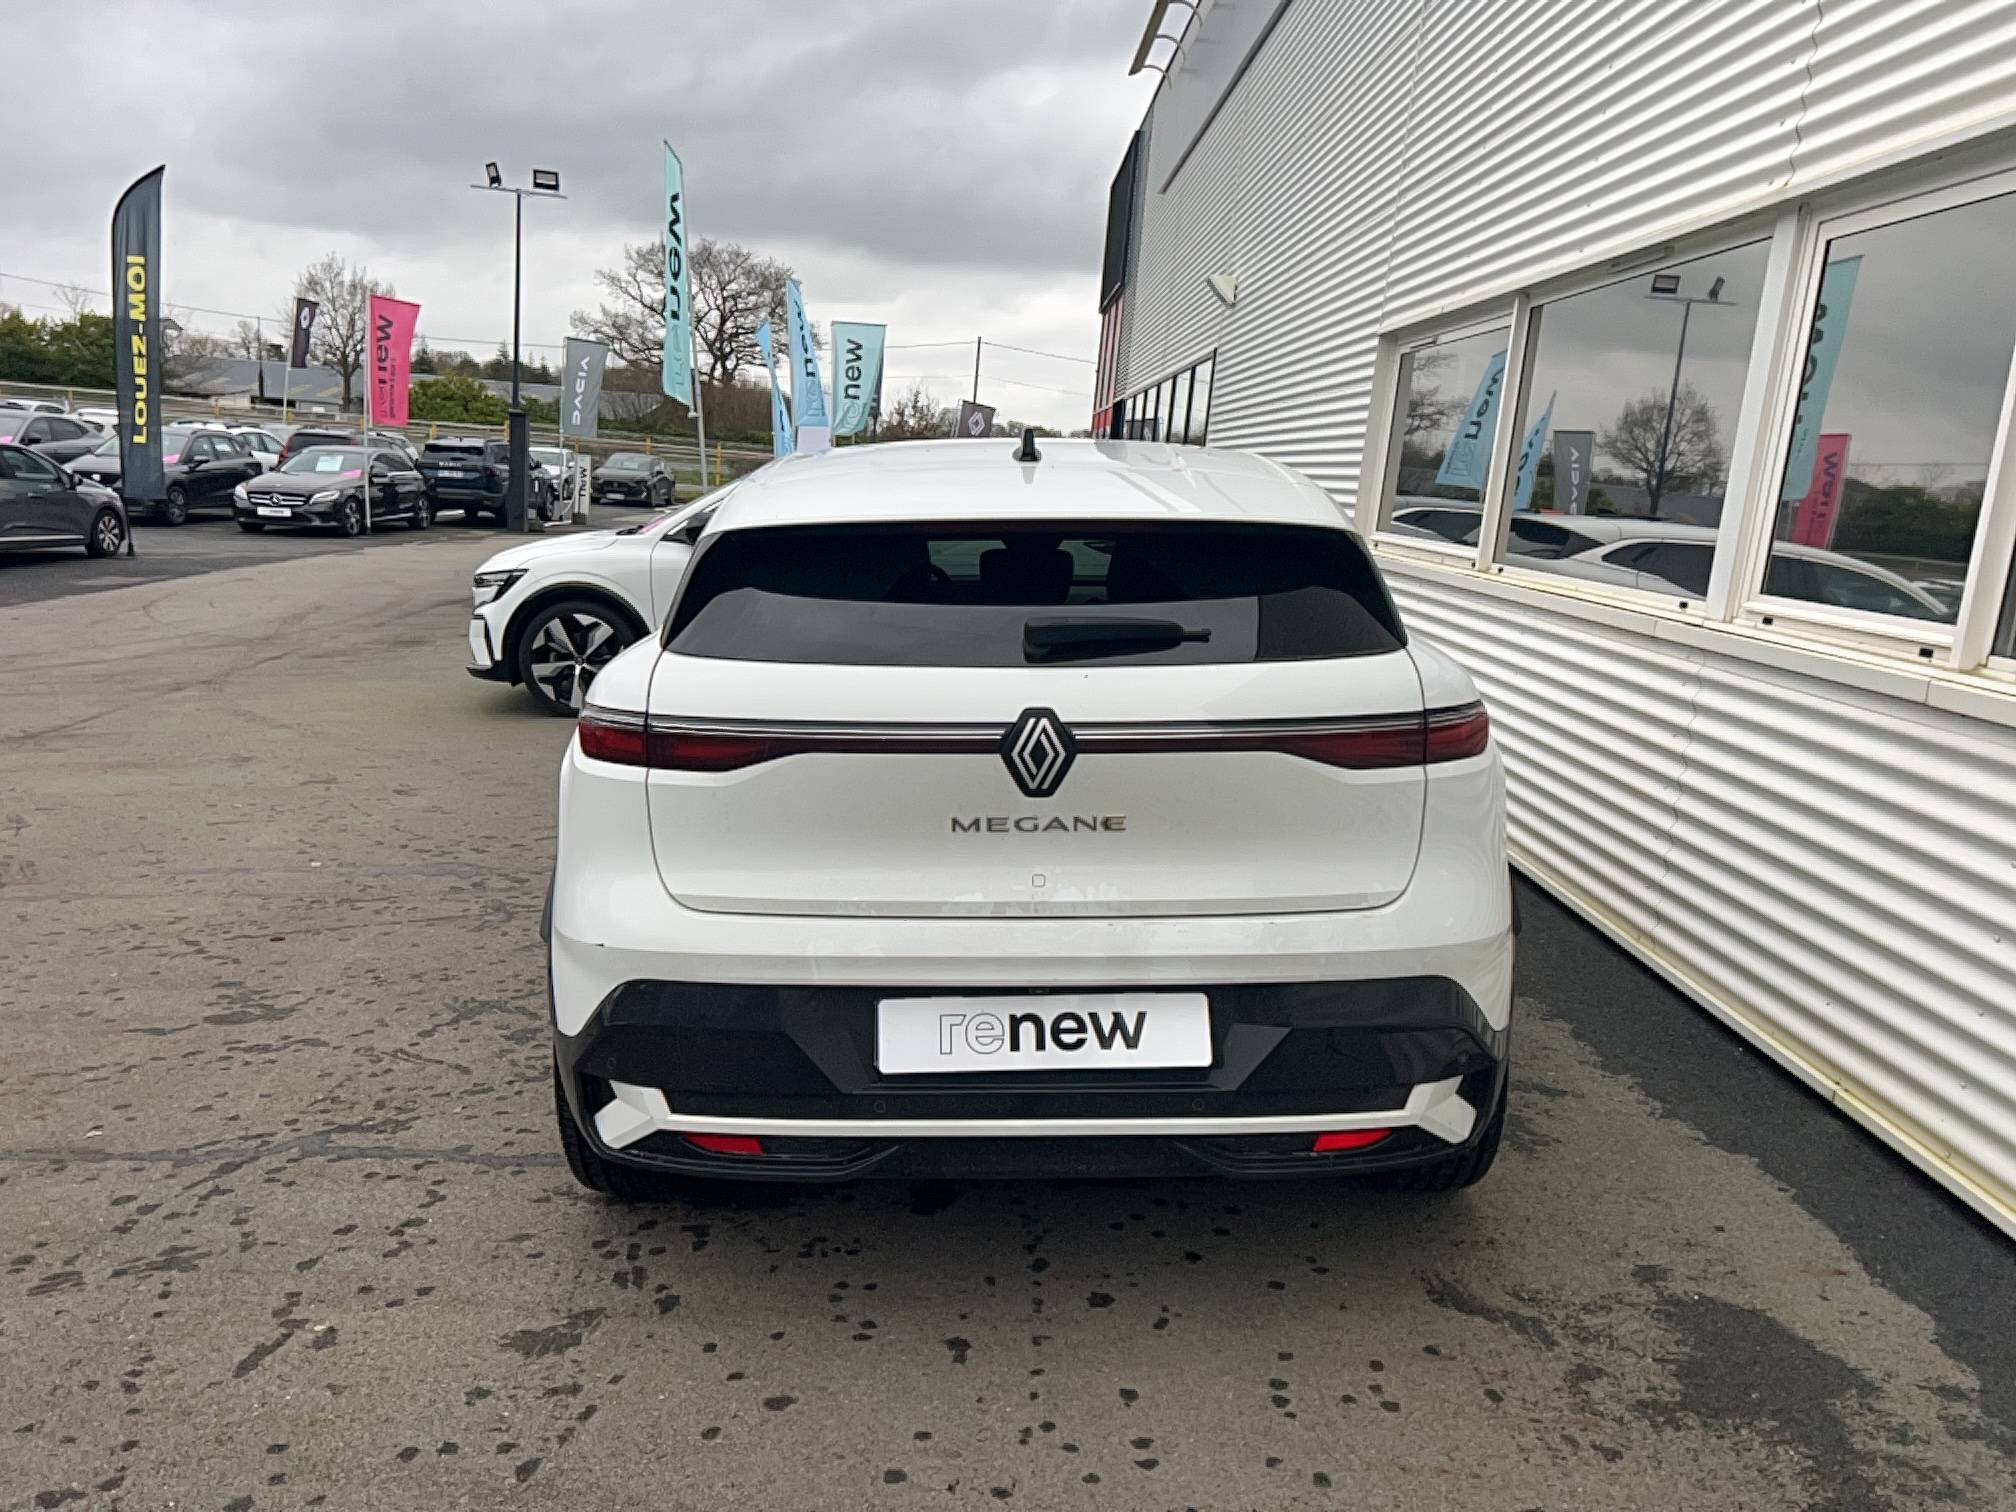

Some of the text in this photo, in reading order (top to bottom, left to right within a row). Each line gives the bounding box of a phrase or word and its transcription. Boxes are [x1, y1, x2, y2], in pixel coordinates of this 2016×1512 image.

[126, 255, 148, 444] LOUEZ-MOI
[571, 355, 590, 426] DACIA
[951, 815, 1127, 833] MEGANE
[939, 1010, 1147, 1055] renew
